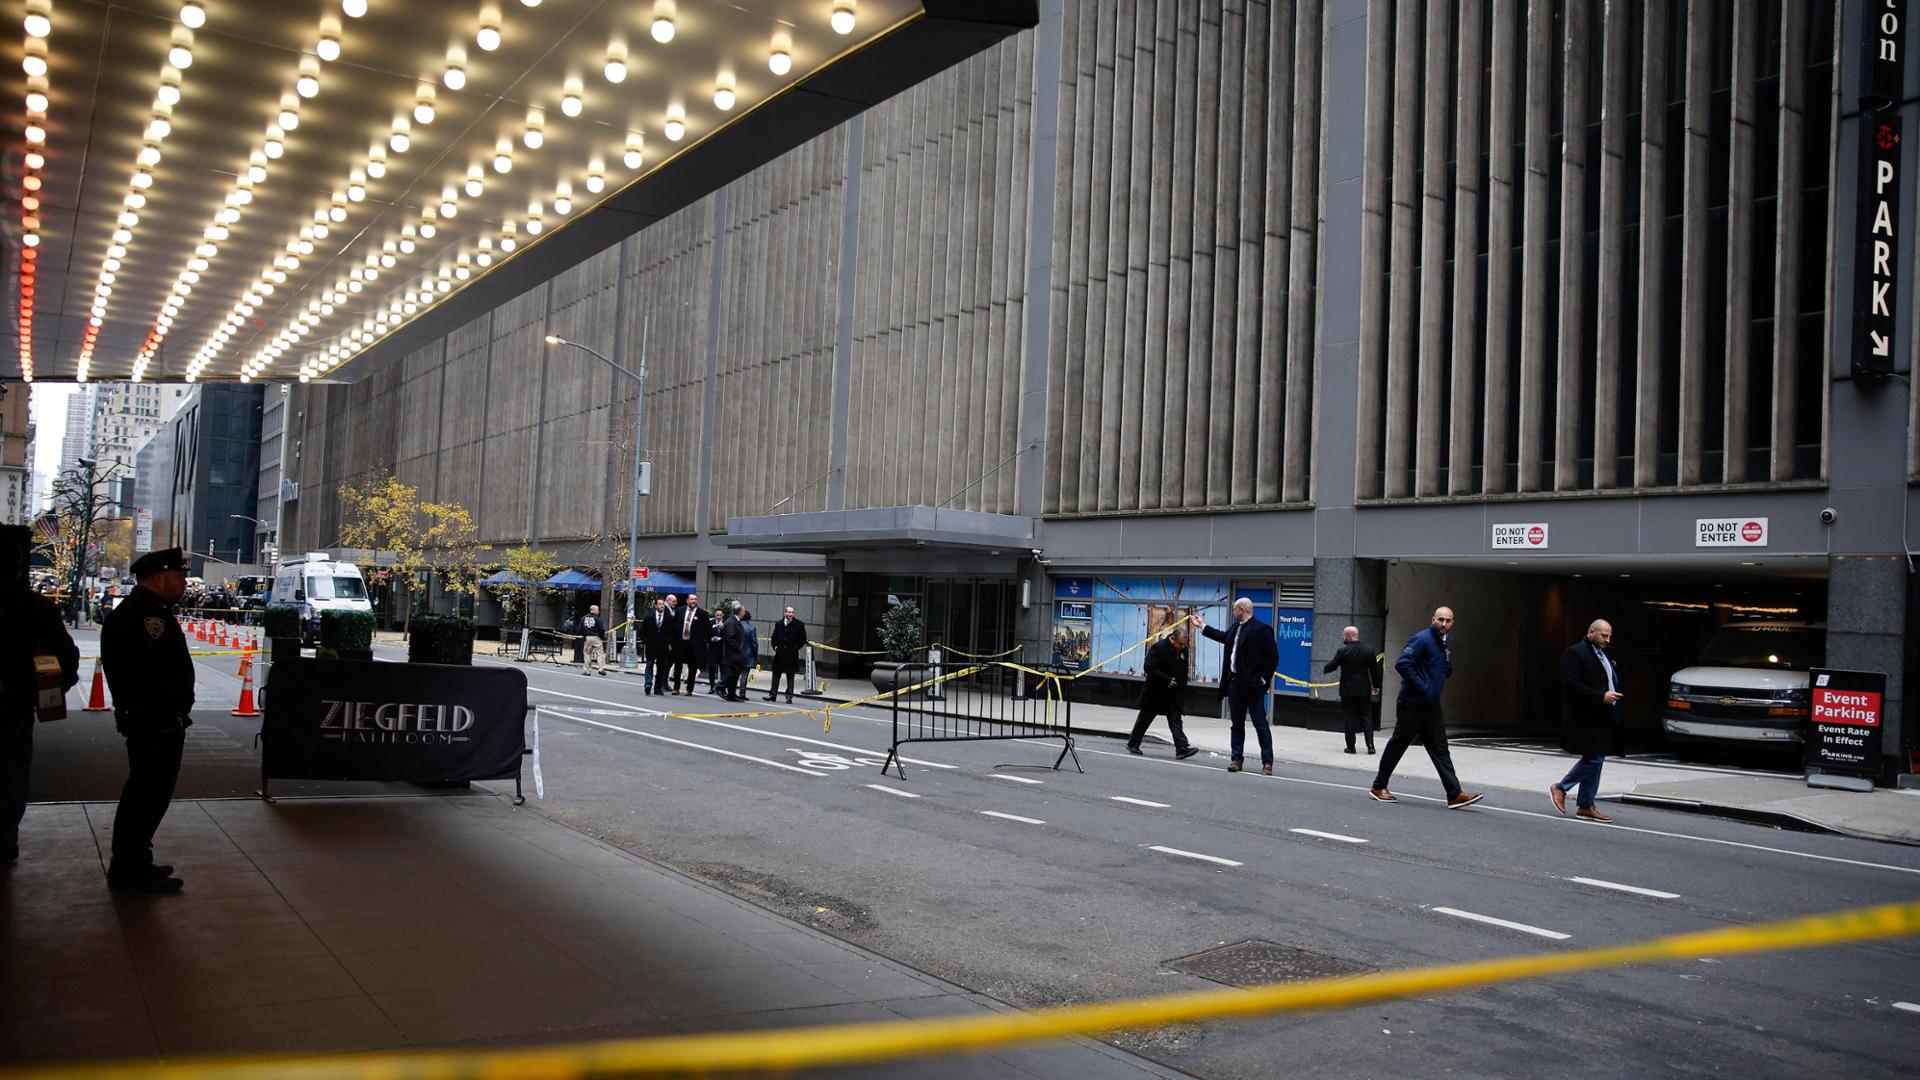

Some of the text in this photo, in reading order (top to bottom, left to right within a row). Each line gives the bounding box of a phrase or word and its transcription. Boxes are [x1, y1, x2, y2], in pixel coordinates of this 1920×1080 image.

[1872, 160, 1894, 317] PARK
[1495, 527, 1525, 536] DO NOT
[1700, 522, 1738, 533] DO NOT
[1496, 536, 1524, 545] ENTER
[1701, 532, 1736, 542] ENTER
[1824, 691, 1868, 706] Event
[320, 700, 474, 732] ZIEGFELD
[1815, 704, 1875, 723] Parking
[1818, 724, 1870, 736] Event Rate
[1823, 735, 1864, 746] In Effect
